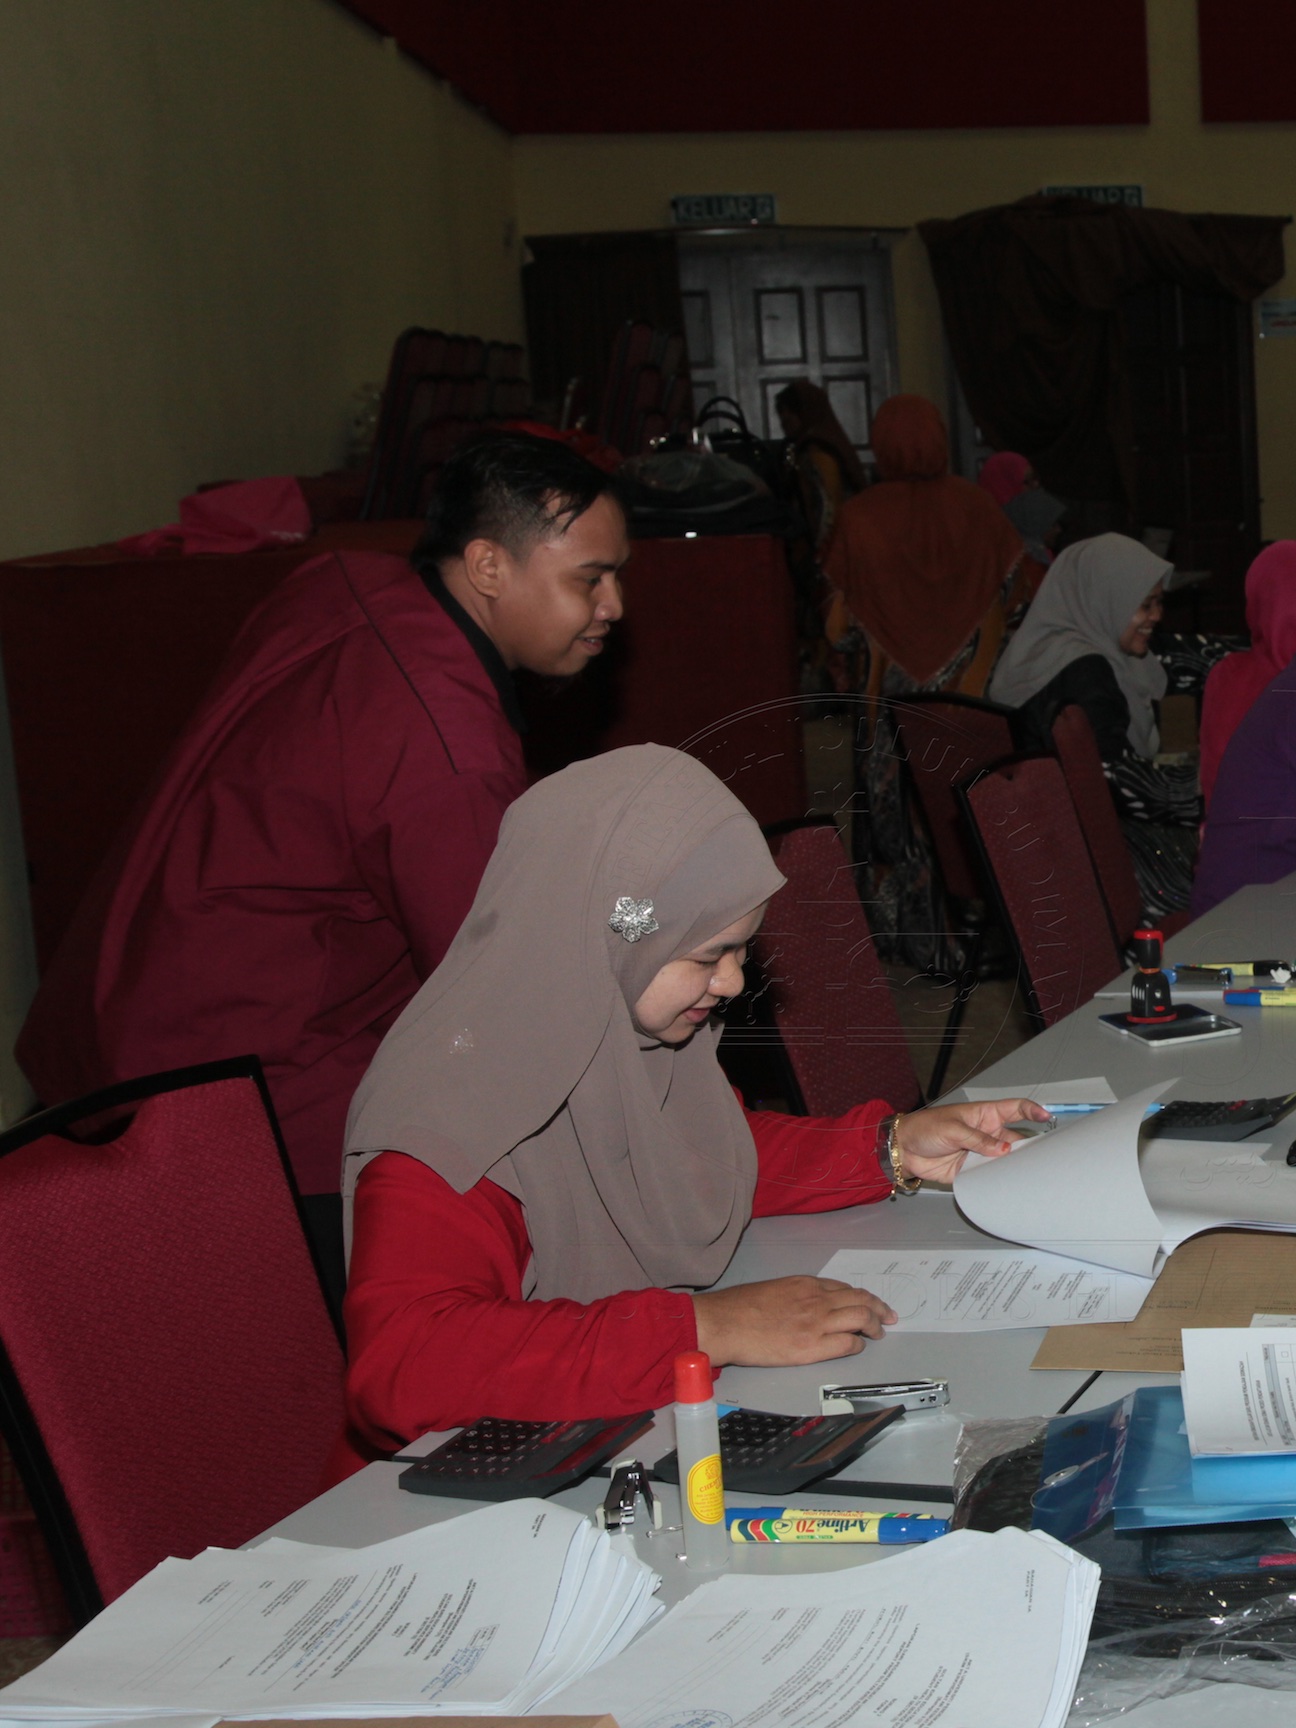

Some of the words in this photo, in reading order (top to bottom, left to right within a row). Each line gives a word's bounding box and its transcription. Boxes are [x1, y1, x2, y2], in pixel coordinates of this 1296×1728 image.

[677, 197, 755, 220] KELUAR
[796, 1519, 816, 1533] 70
[817, 1519, 871, 1533] Artline
